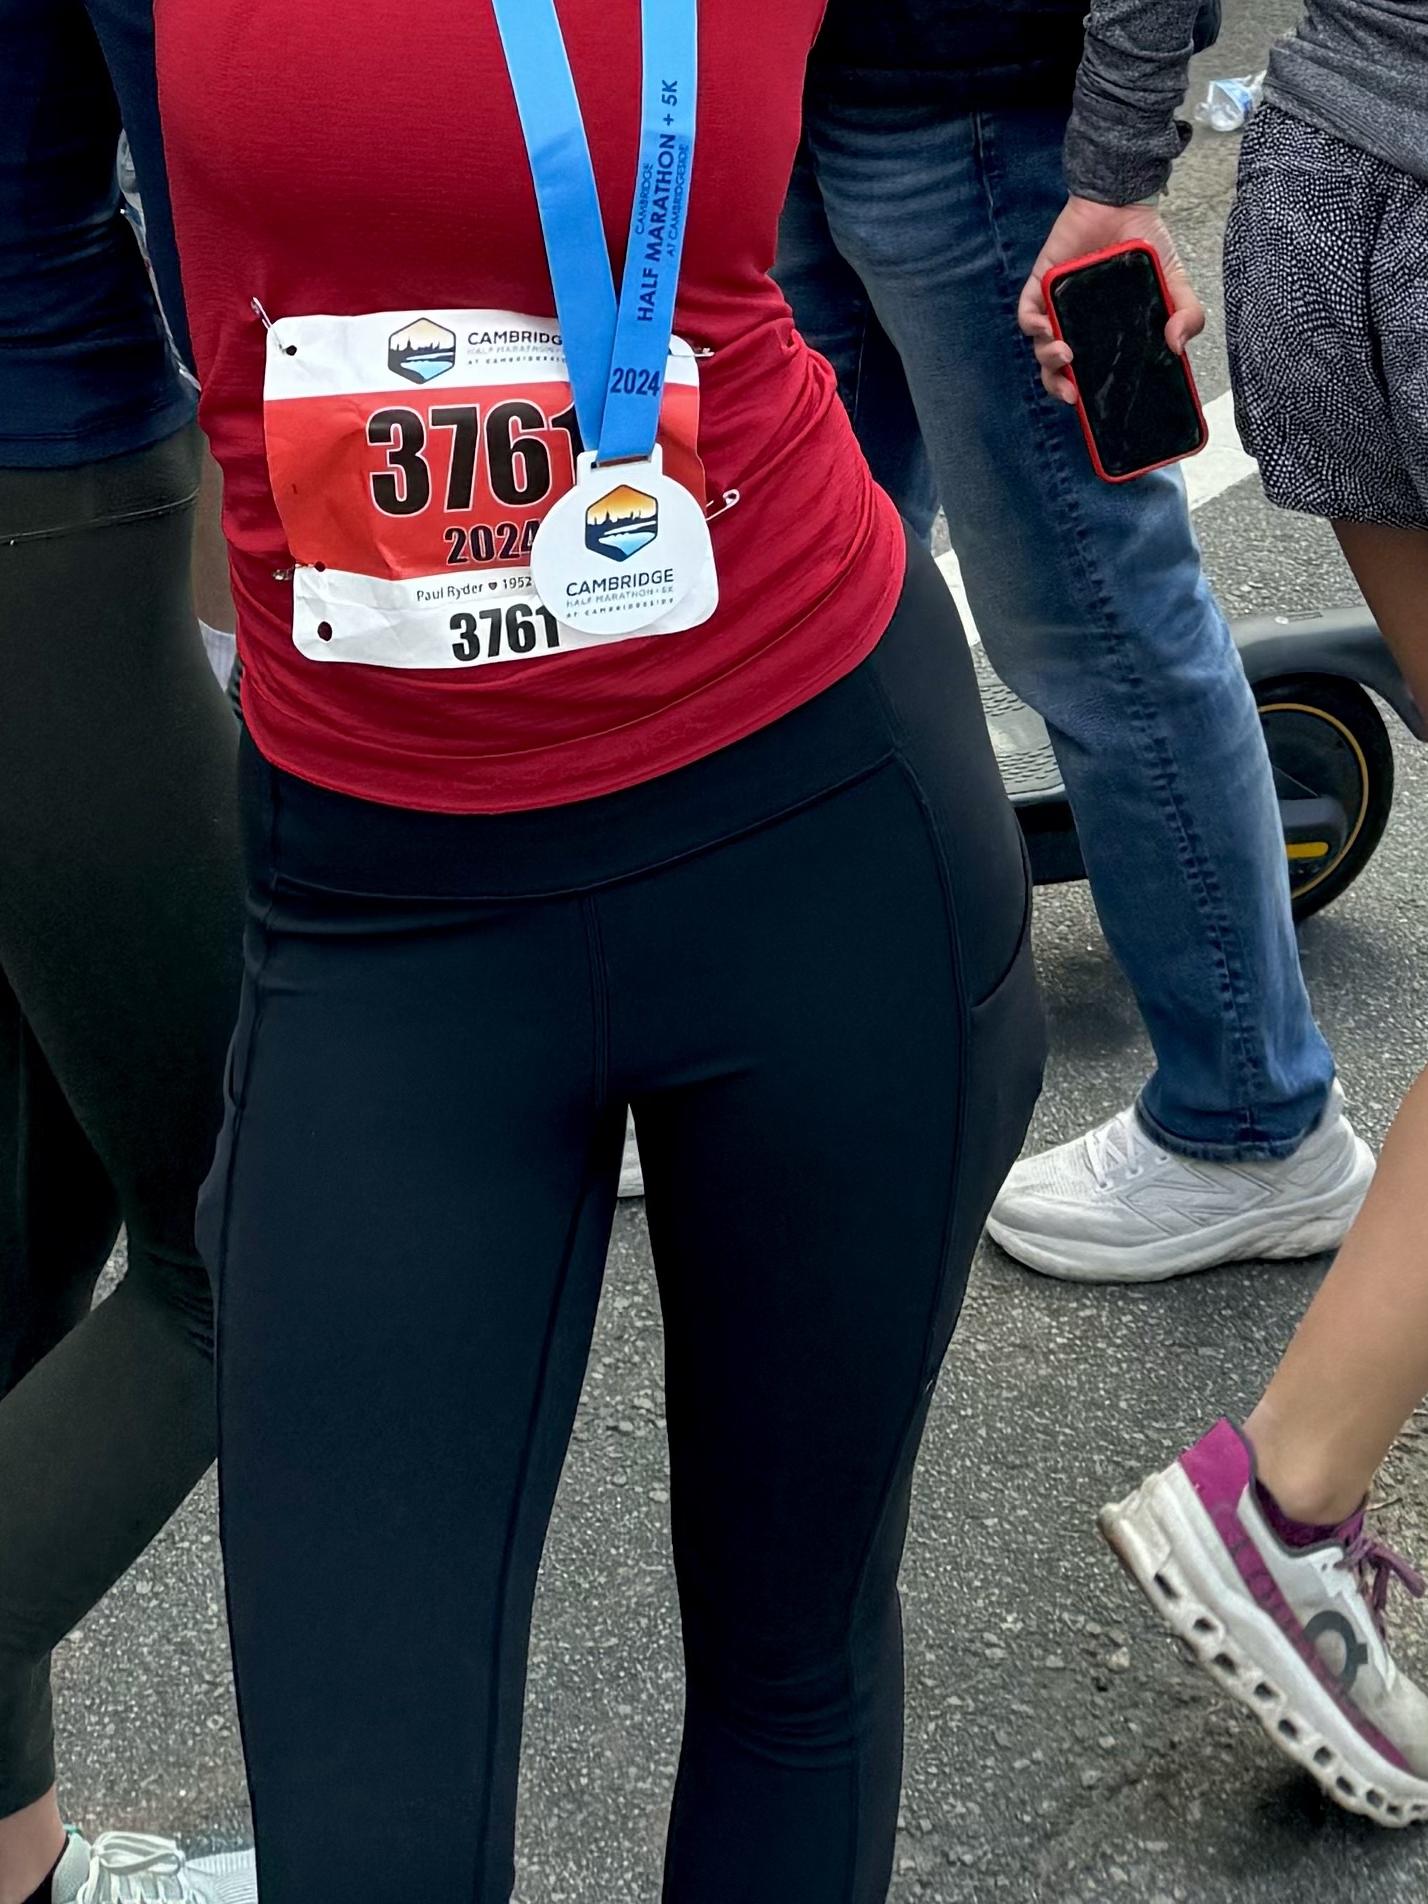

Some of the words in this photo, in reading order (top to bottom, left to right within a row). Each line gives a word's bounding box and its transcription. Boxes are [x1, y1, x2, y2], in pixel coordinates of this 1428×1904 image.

[661, 79, 678, 107] 5K
[645, 132, 676, 262] MARATHON
[637, 268, 659, 322] HALF
[467, 330, 563, 345] CAMBRIDG
[610, 368, 660, 396] 2024
[366, 399, 584, 517] 3761
[443, 519, 541, 566] 2024
[416, 586, 444, 602] Paul
[447, 583, 484, 600] Ryder
[502, 576, 532, 590] 1952
[566, 568, 674, 597] CAMBRIDGE
[595, 587, 653, 604] MARATHON
[449, 603, 560, 662] 3761
